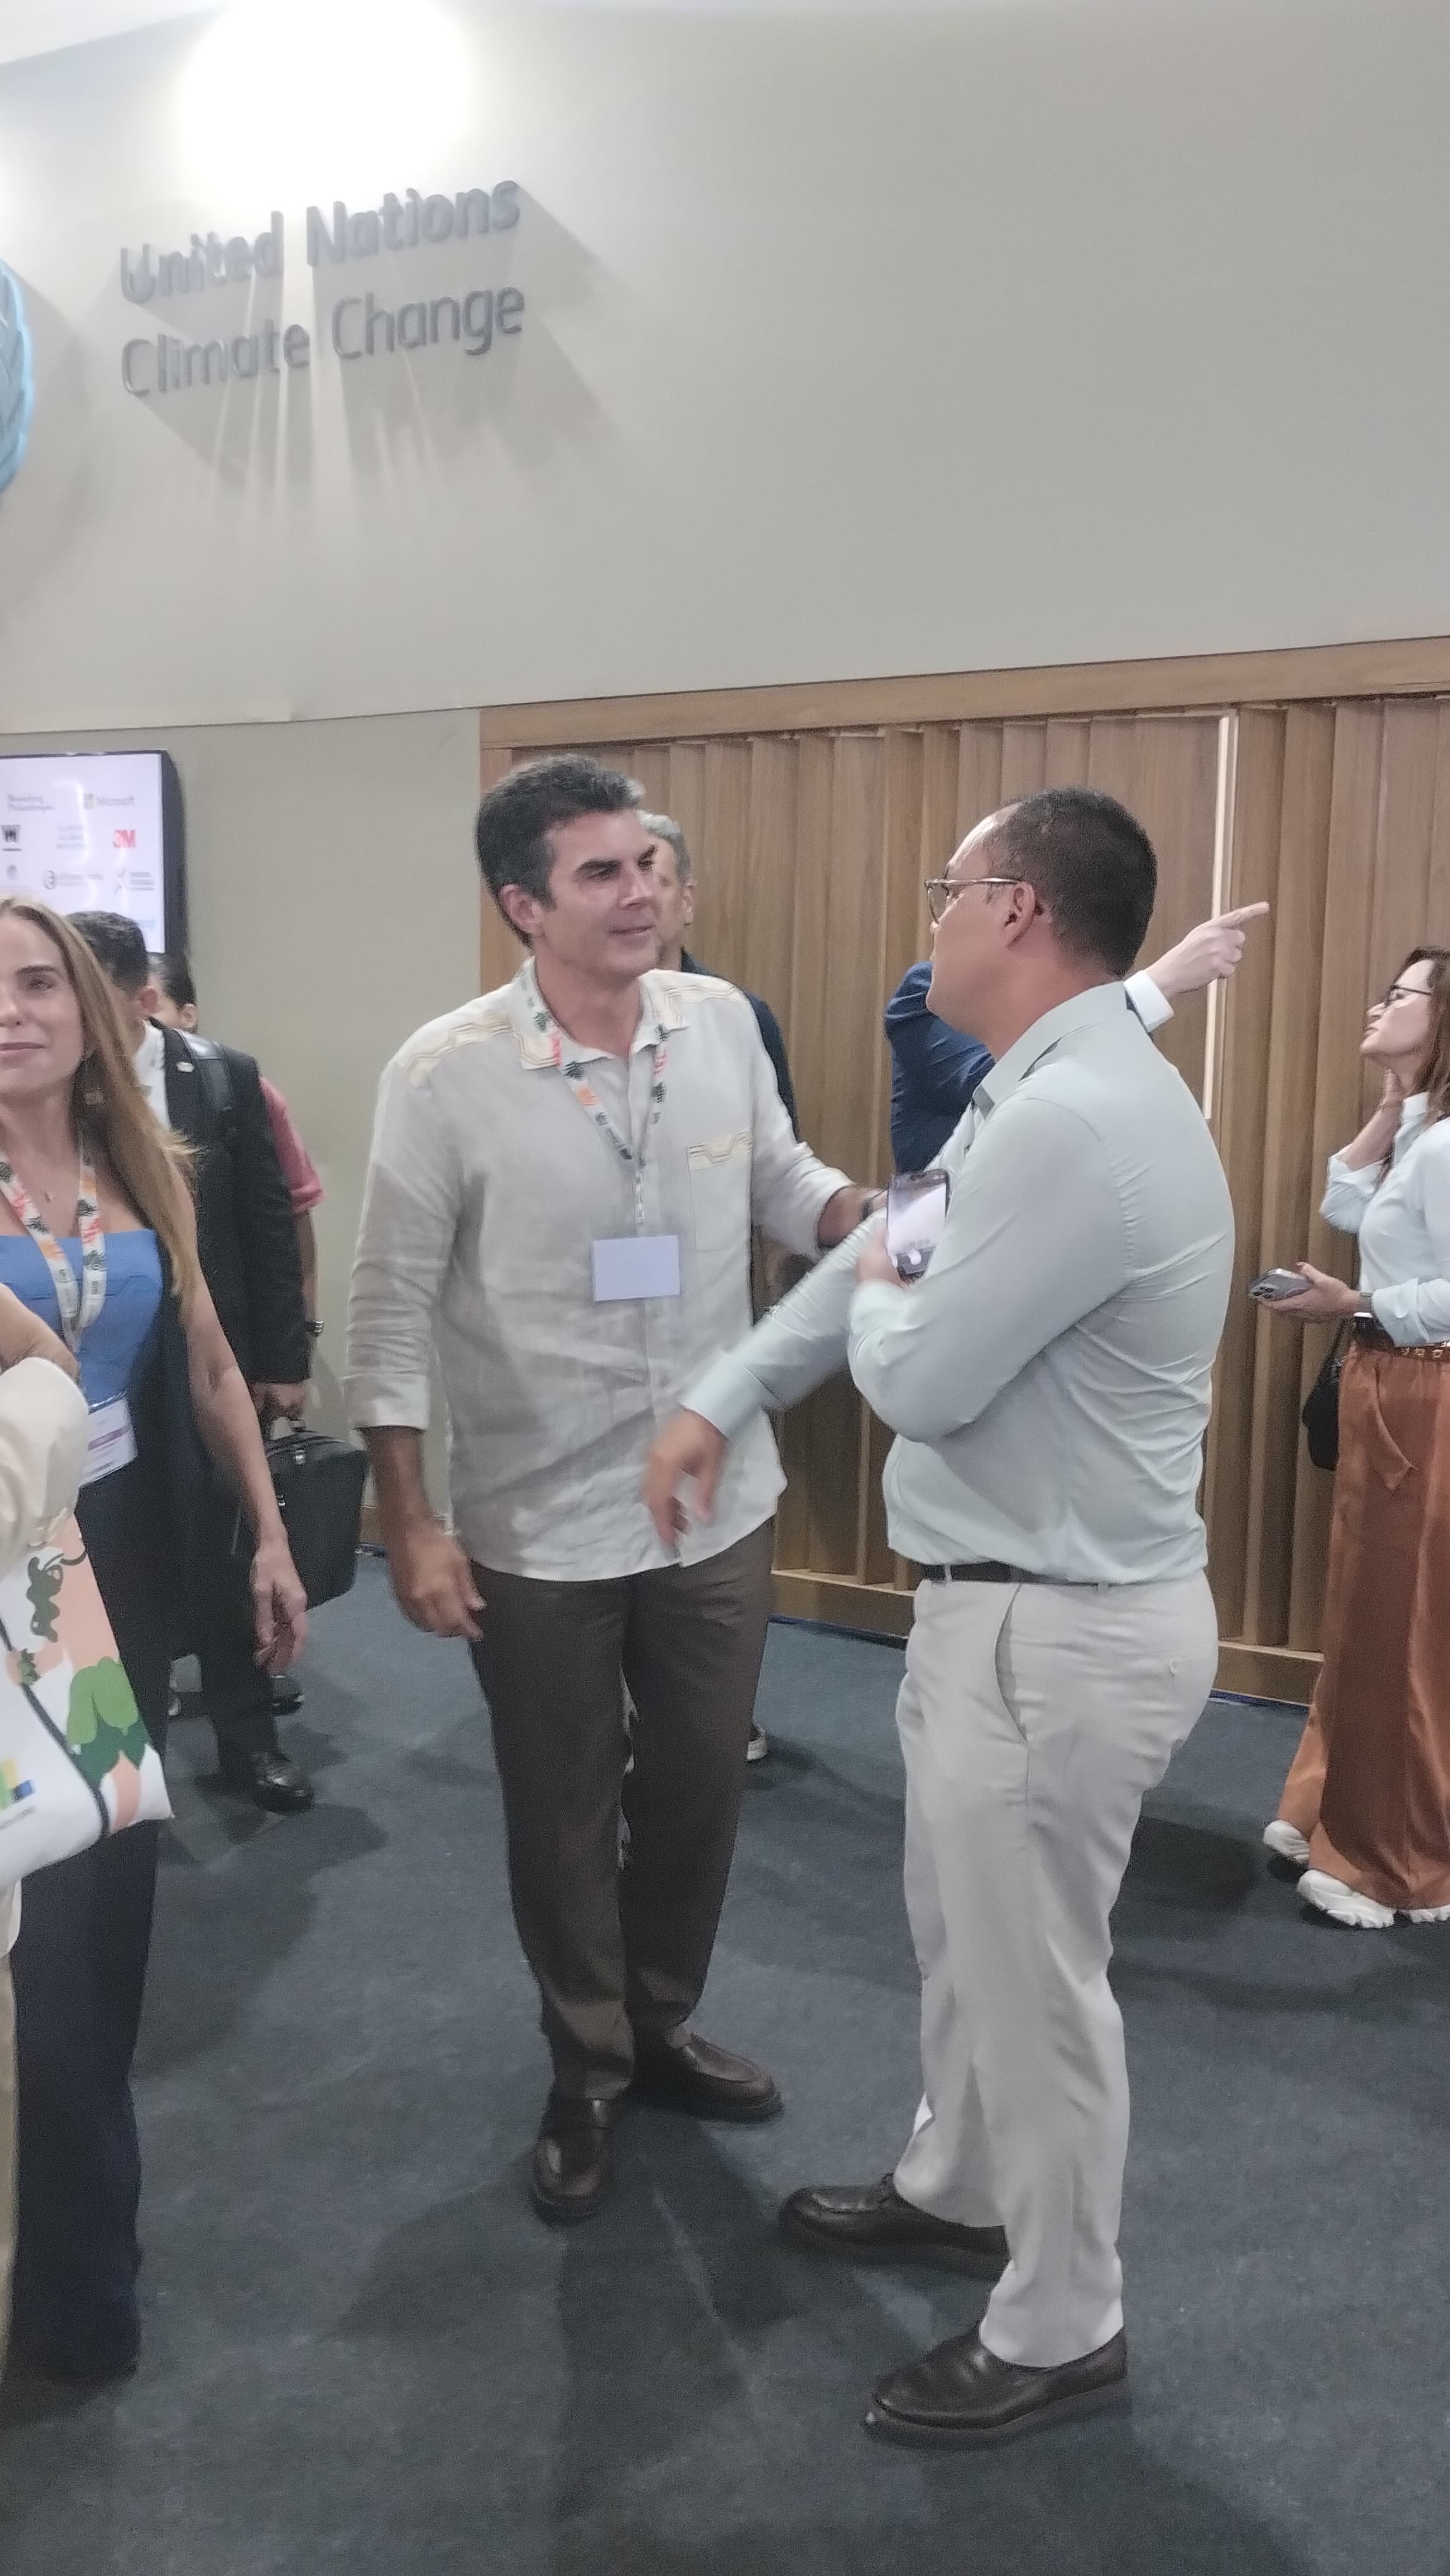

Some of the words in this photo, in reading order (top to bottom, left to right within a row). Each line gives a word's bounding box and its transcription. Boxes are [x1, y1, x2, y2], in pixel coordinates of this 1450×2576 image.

[120, 211, 284, 304] United
[306, 180, 521, 267] Nations
[122, 318, 310, 397] Climate
[332, 286, 525, 359] Change
